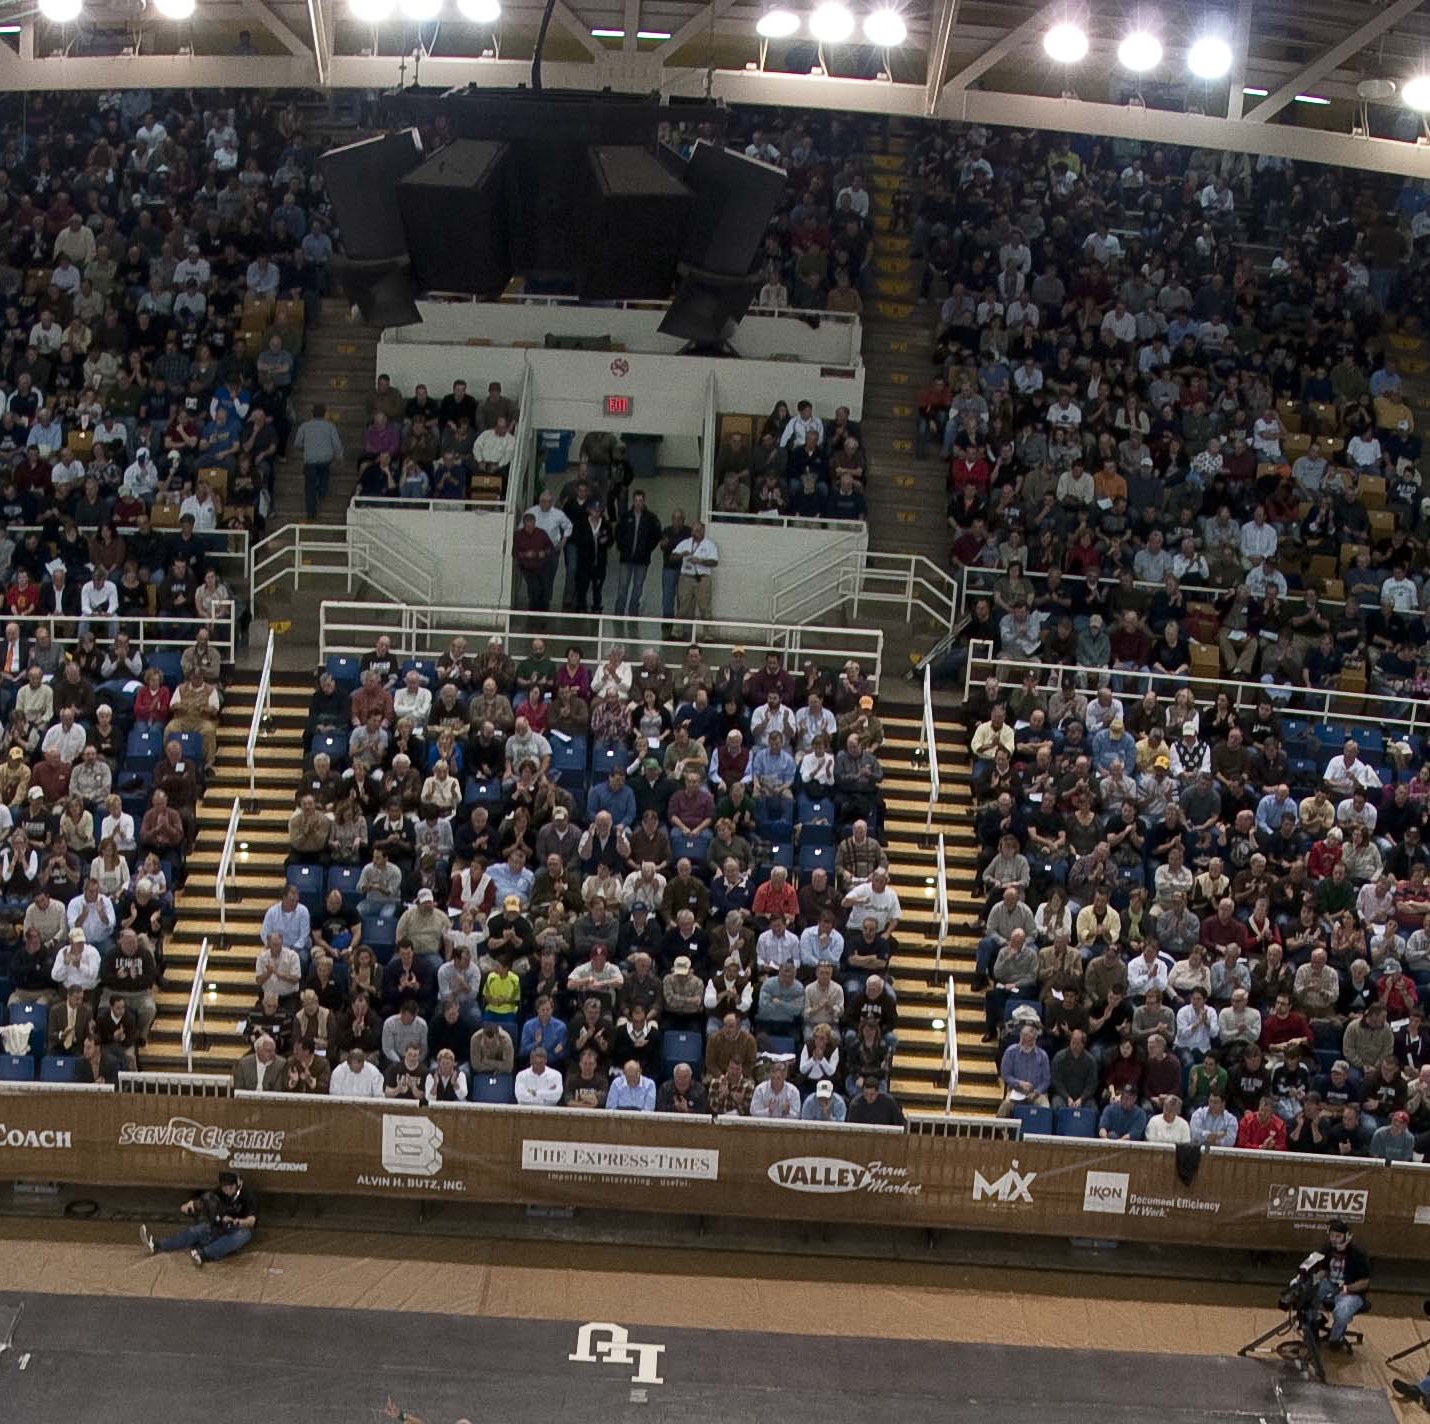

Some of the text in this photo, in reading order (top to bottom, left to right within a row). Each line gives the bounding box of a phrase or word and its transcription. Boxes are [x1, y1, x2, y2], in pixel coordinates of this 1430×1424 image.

[119, 1122, 285, 1150] SERVICE ELECTRIC
[529, 1147, 710, 1171] THE EXPRESS-TIMES
[357, 1174, 467, 1191] ALVIN H. BUTZ, INC.
[777, 1161, 908, 1188] VALLEY Farm
[867, 1179, 921, 1196] Market
[1089, 1186, 1123, 1201] IKON
[1130, 1194, 1221, 1212] Document Efficiency
[1300, 1190, 1365, 1211] NEWS
